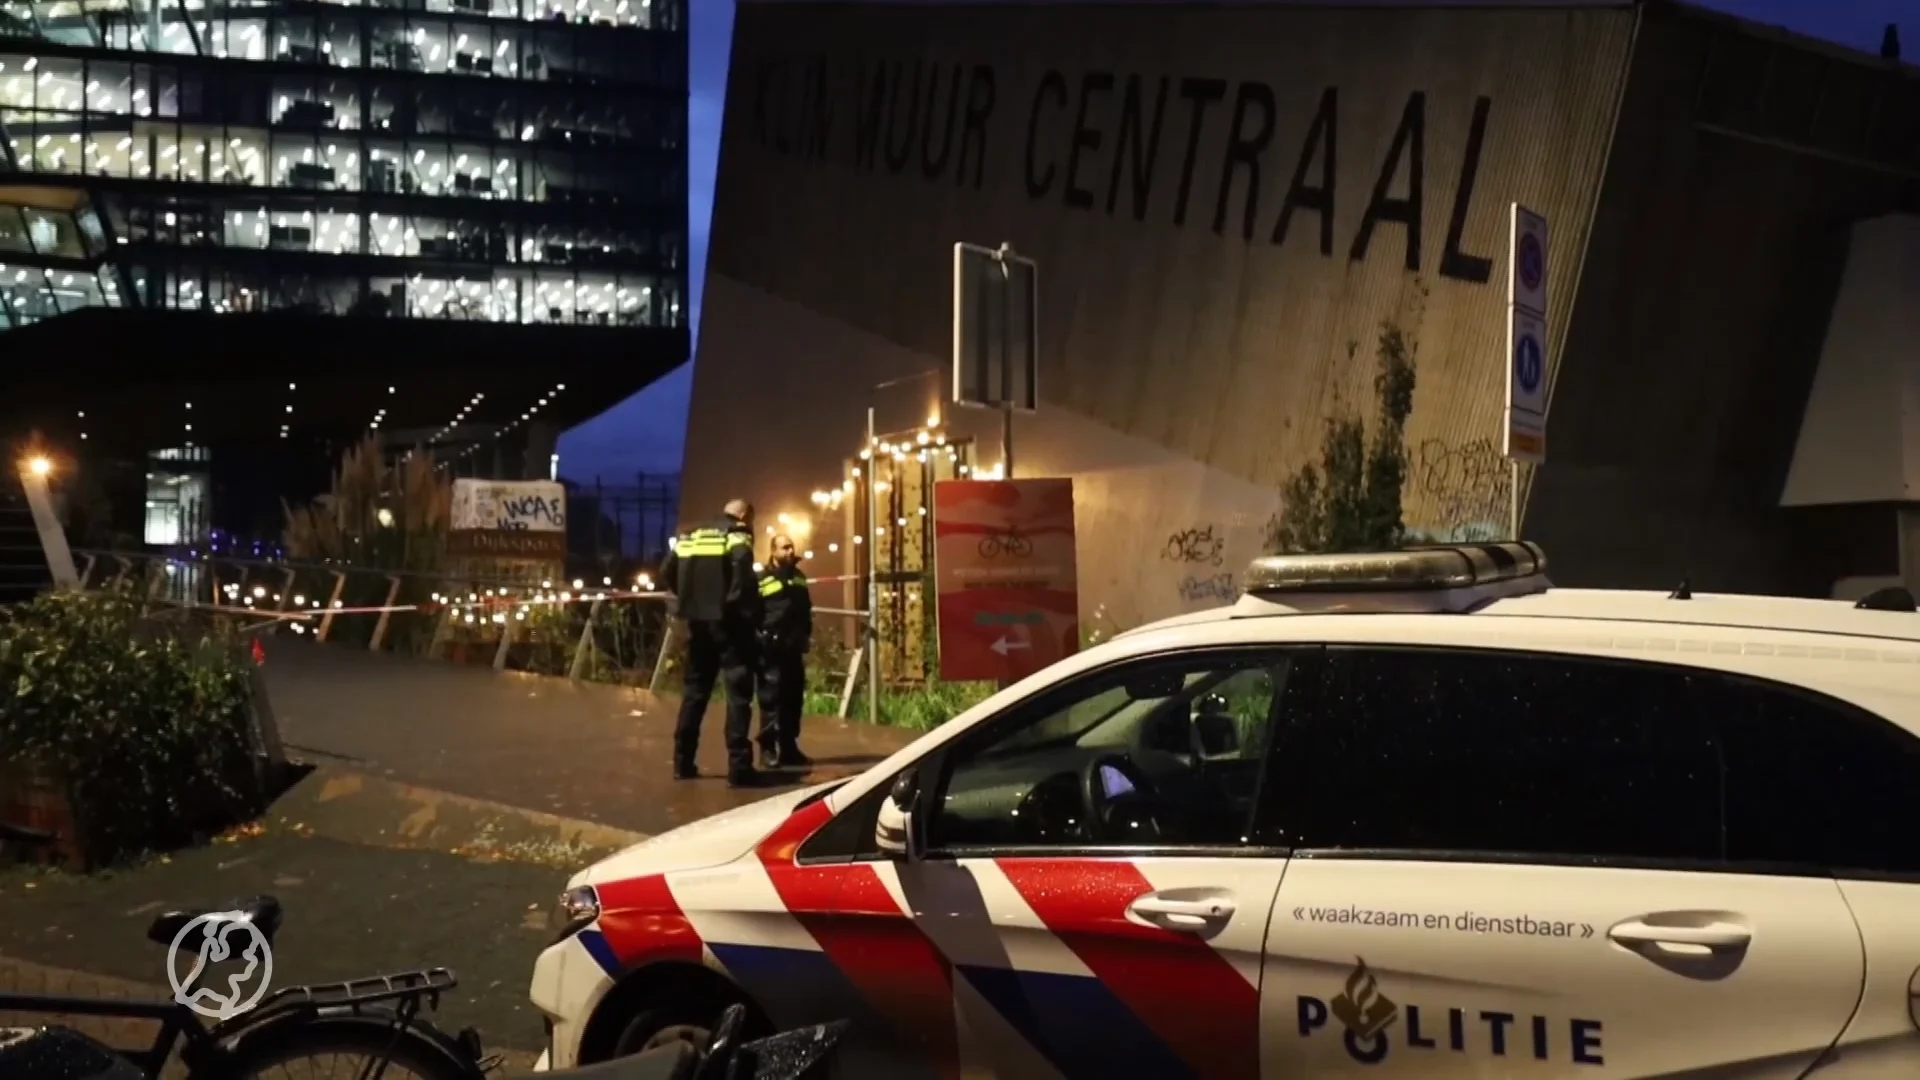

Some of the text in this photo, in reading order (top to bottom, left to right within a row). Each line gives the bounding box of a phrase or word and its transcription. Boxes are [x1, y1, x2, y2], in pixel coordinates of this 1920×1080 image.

[1024, 68, 1494, 283] CENTRAAL
[1309, 904, 1419, 928] waakzaam
[1423, 914, 1450, 930] en
[1455, 911, 1575, 938] dienstbaar
[1297, 995, 1605, 1066] POLITIE
